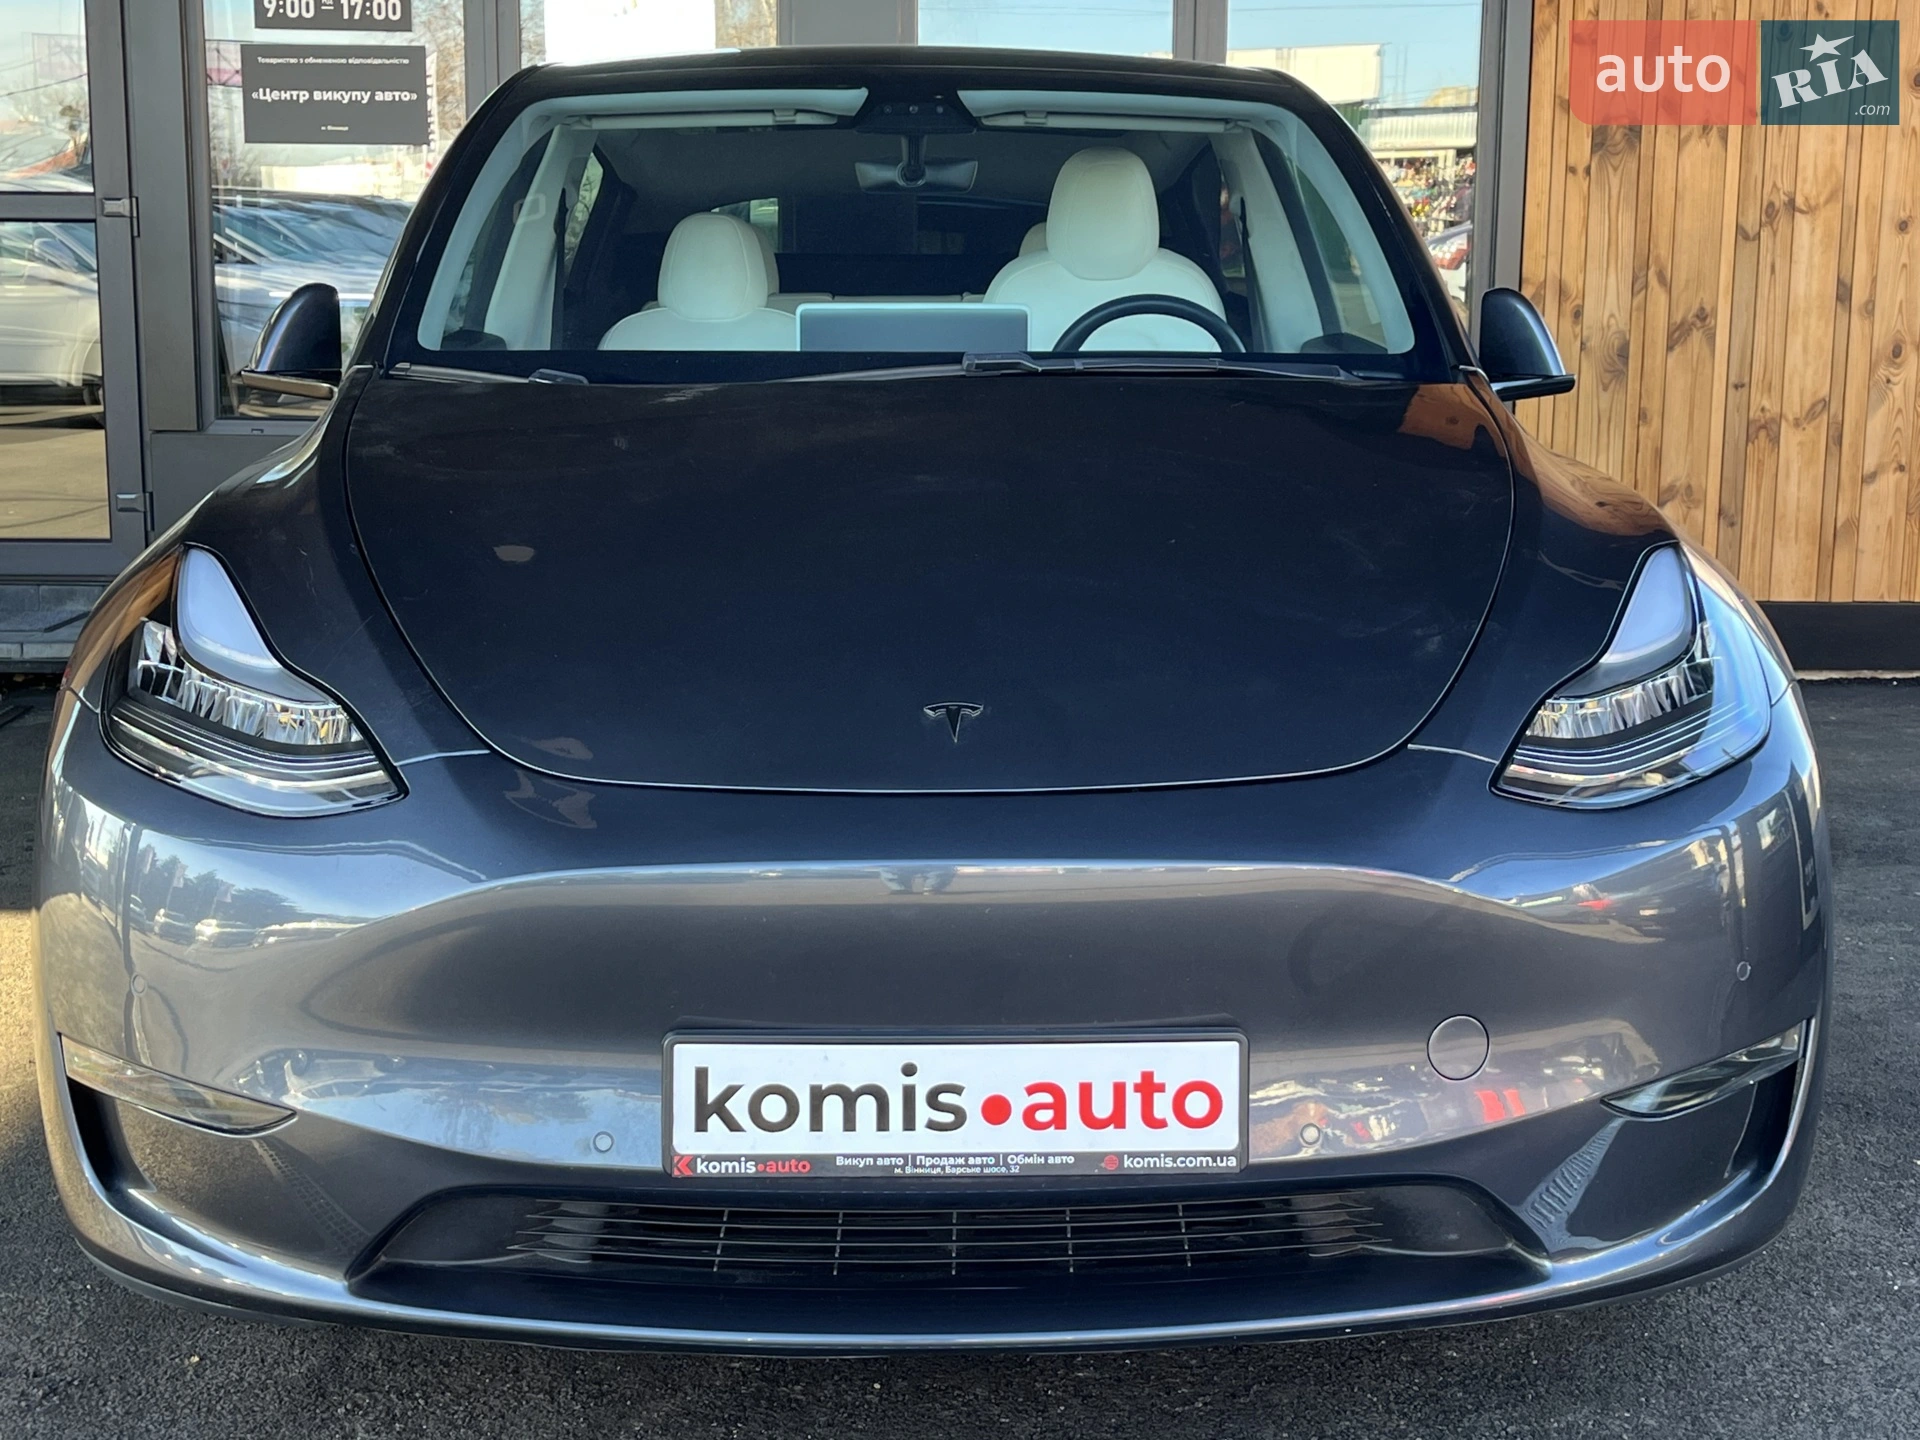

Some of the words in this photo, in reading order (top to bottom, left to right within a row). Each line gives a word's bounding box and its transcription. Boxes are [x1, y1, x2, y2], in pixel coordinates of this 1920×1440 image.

[263, 0, 315, 18] 9:00
[340, 0, 402, 21] 17:00
[251, 87, 310, 103] «Центр
[313, 90, 372, 104] викупу
[374, 91, 418, 102] авто»
[835, 1155, 873, 1167] Викуп
[876, 1157, 904, 1166] авто
[916, 1155, 965, 1167] Продаж
[967, 1156, 995, 1166] авто
[1007, 1153, 1045, 1165] Обмін
[1047, 1155, 1075, 1164] авто
[1123, 1153, 1237, 1168] komis.com.ua
[945, 1165, 981, 1175] Барське
[1009, 1165, 1020, 1173] 32
